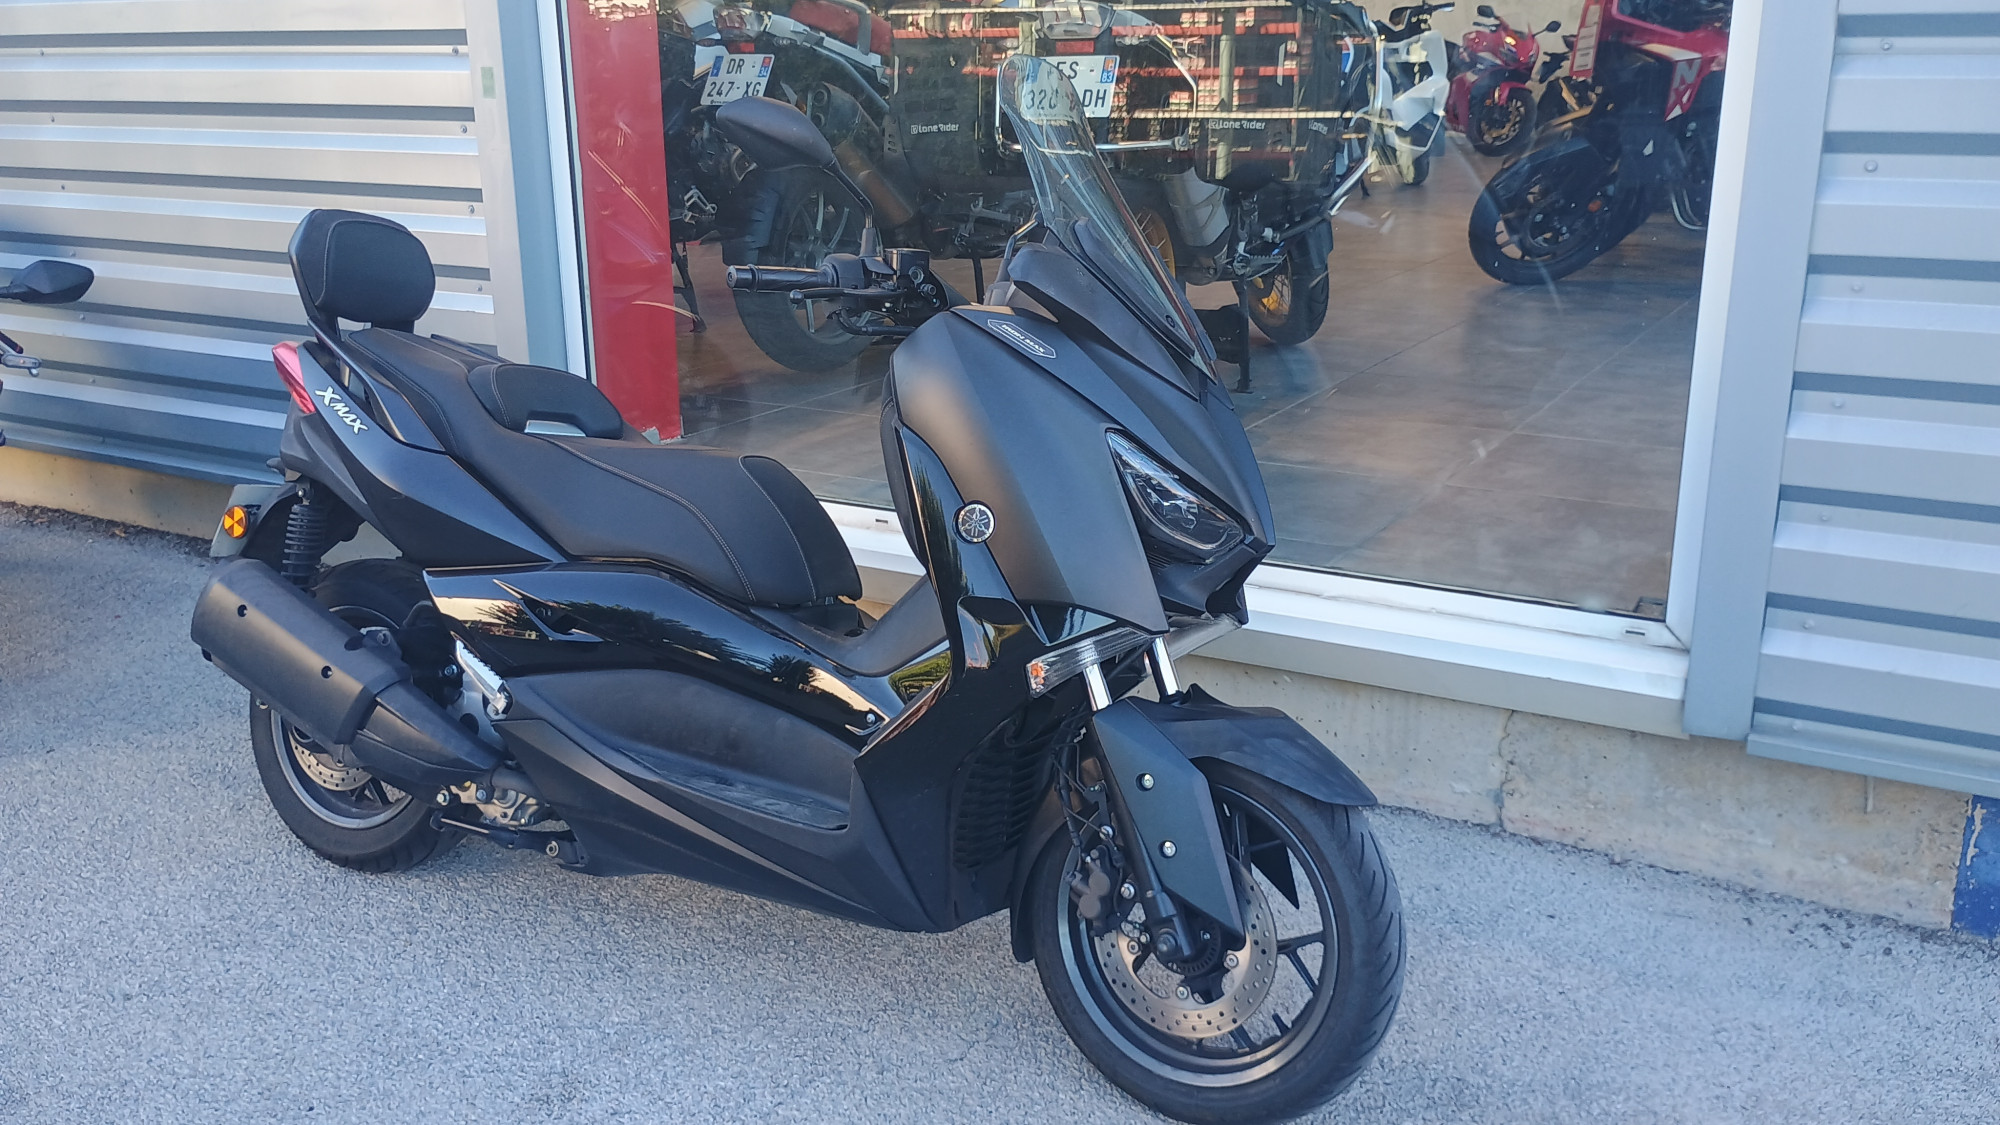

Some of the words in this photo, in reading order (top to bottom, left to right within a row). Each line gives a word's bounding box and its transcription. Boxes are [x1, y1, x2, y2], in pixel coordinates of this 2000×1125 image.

[726, 58, 745, 75] DR
[1101, 72, 1113, 83] 83
[1082, 88, 1107, 108] DH
